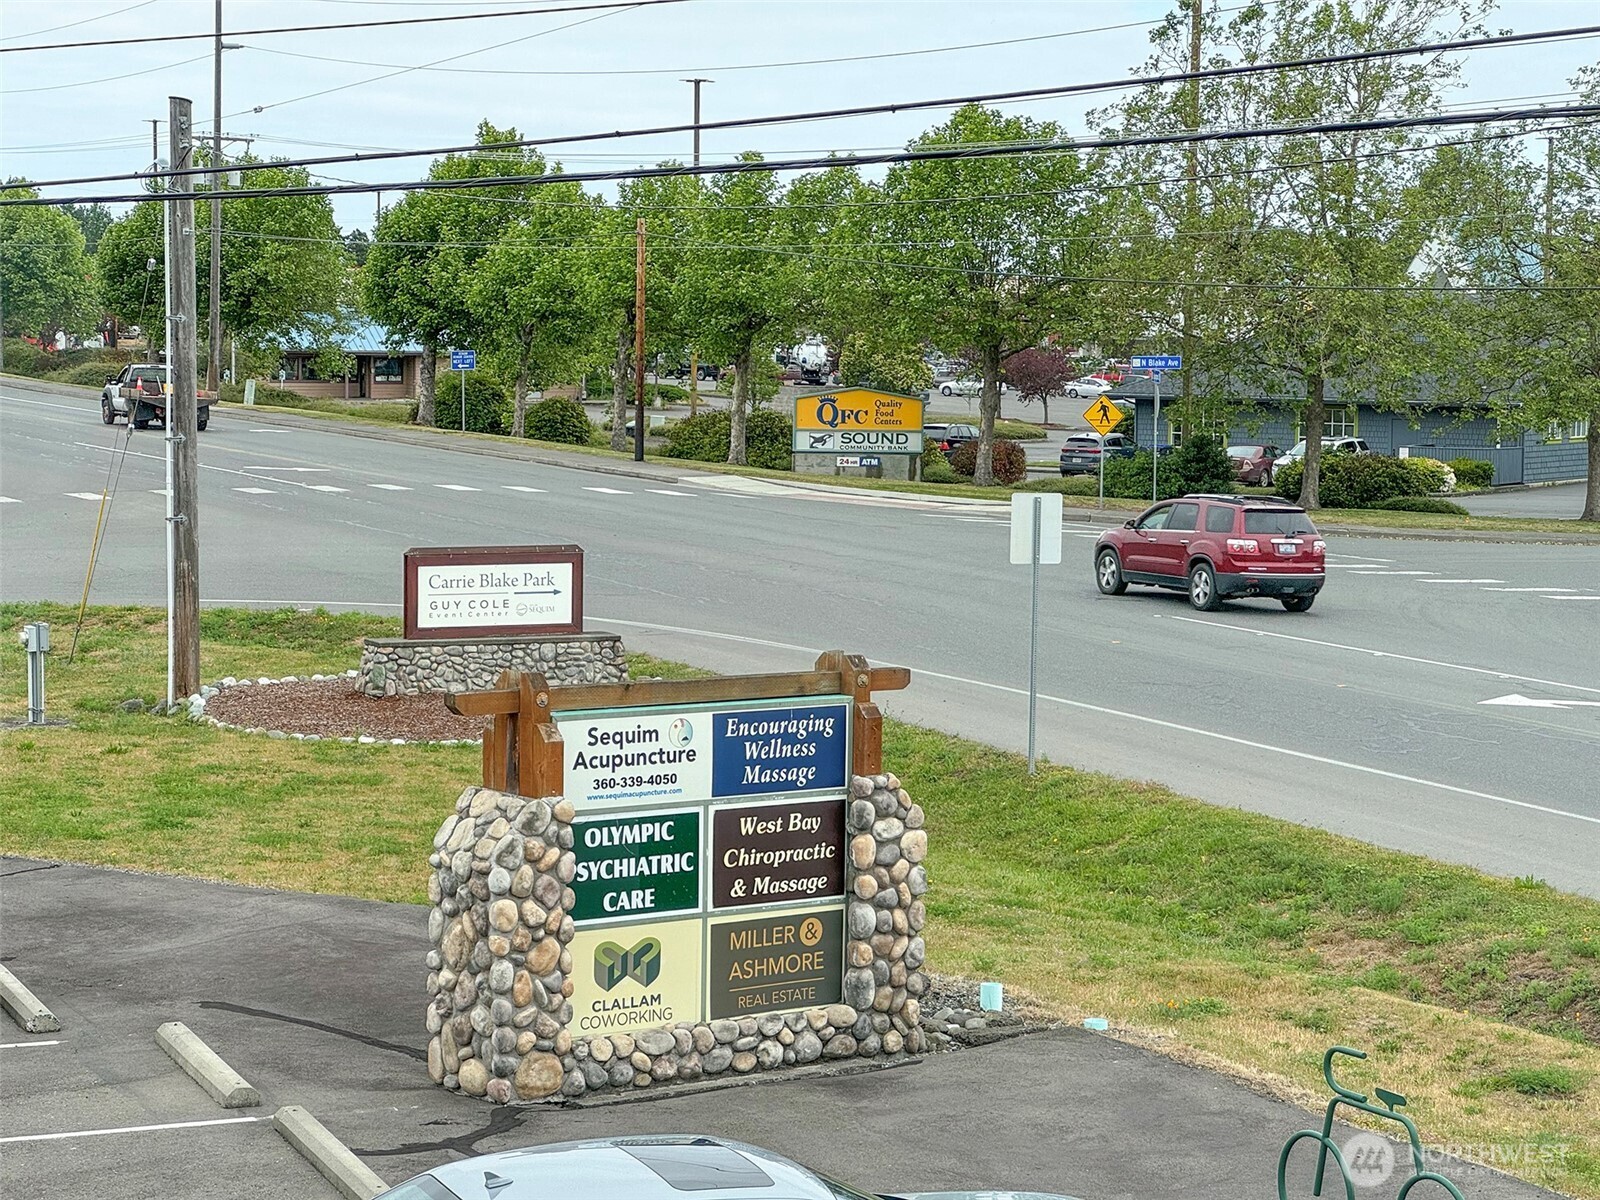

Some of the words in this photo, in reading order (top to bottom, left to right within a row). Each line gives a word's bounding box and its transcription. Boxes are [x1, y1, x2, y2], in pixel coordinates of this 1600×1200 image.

[1141, 358, 1147, 367] N
[1148, 358, 1166, 367] Blake
[1167, 358, 1179, 367] Ave
[816, 402, 869, 428] QFC
[874, 399, 903, 409] Quality
[875, 409, 894, 417] Food
[874, 417, 903, 426] Centers
[840, 432, 909, 445] SOUND
[428, 574, 475, 590] Carrie
[479, 572, 519, 588] Blake
[523, 571, 556, 587] Park
[429, 600, 462, 611] GUY
[468, 599, 510, 610] COLE
[429, 611, 463, 619] Event
[467, 610, 509, 618] Center
[587, 724, 659, 750] Sequim
[725, 713, 835, 740] Encouraging
[573, 748, 697, 773] Acupuncture
[744, 738, 816, 761] Wellness
[593, 773, 678, 790] 360-339-4050
[741, 764, 816, 787] Massage
[586, 787, 682, 801] www.sequimacupuncture.com
[584, 821, 675, 848] OLYMPIC
[739, 815, 783, 836] West
[787, 812, 822, 835] Bay
[575, 852, 694, 883] SYCHIATRIC
[723, 842, 836, 870] Chiropractic
[730, 878, 748, 899] &
[751, 873, 828, 898] Massage
[602, 888, 655, 912] CARE
[729, 925, 796, 951] MILLER
[728, 951, 825, 981] ASHMORE
[591, 993, 662, 1013] CLALLAM
[737, 992, 770, 1009] REAL
[771, 987, 816, 1006] ESTATE
[580, 1006, 673, 1032] COWORKING
